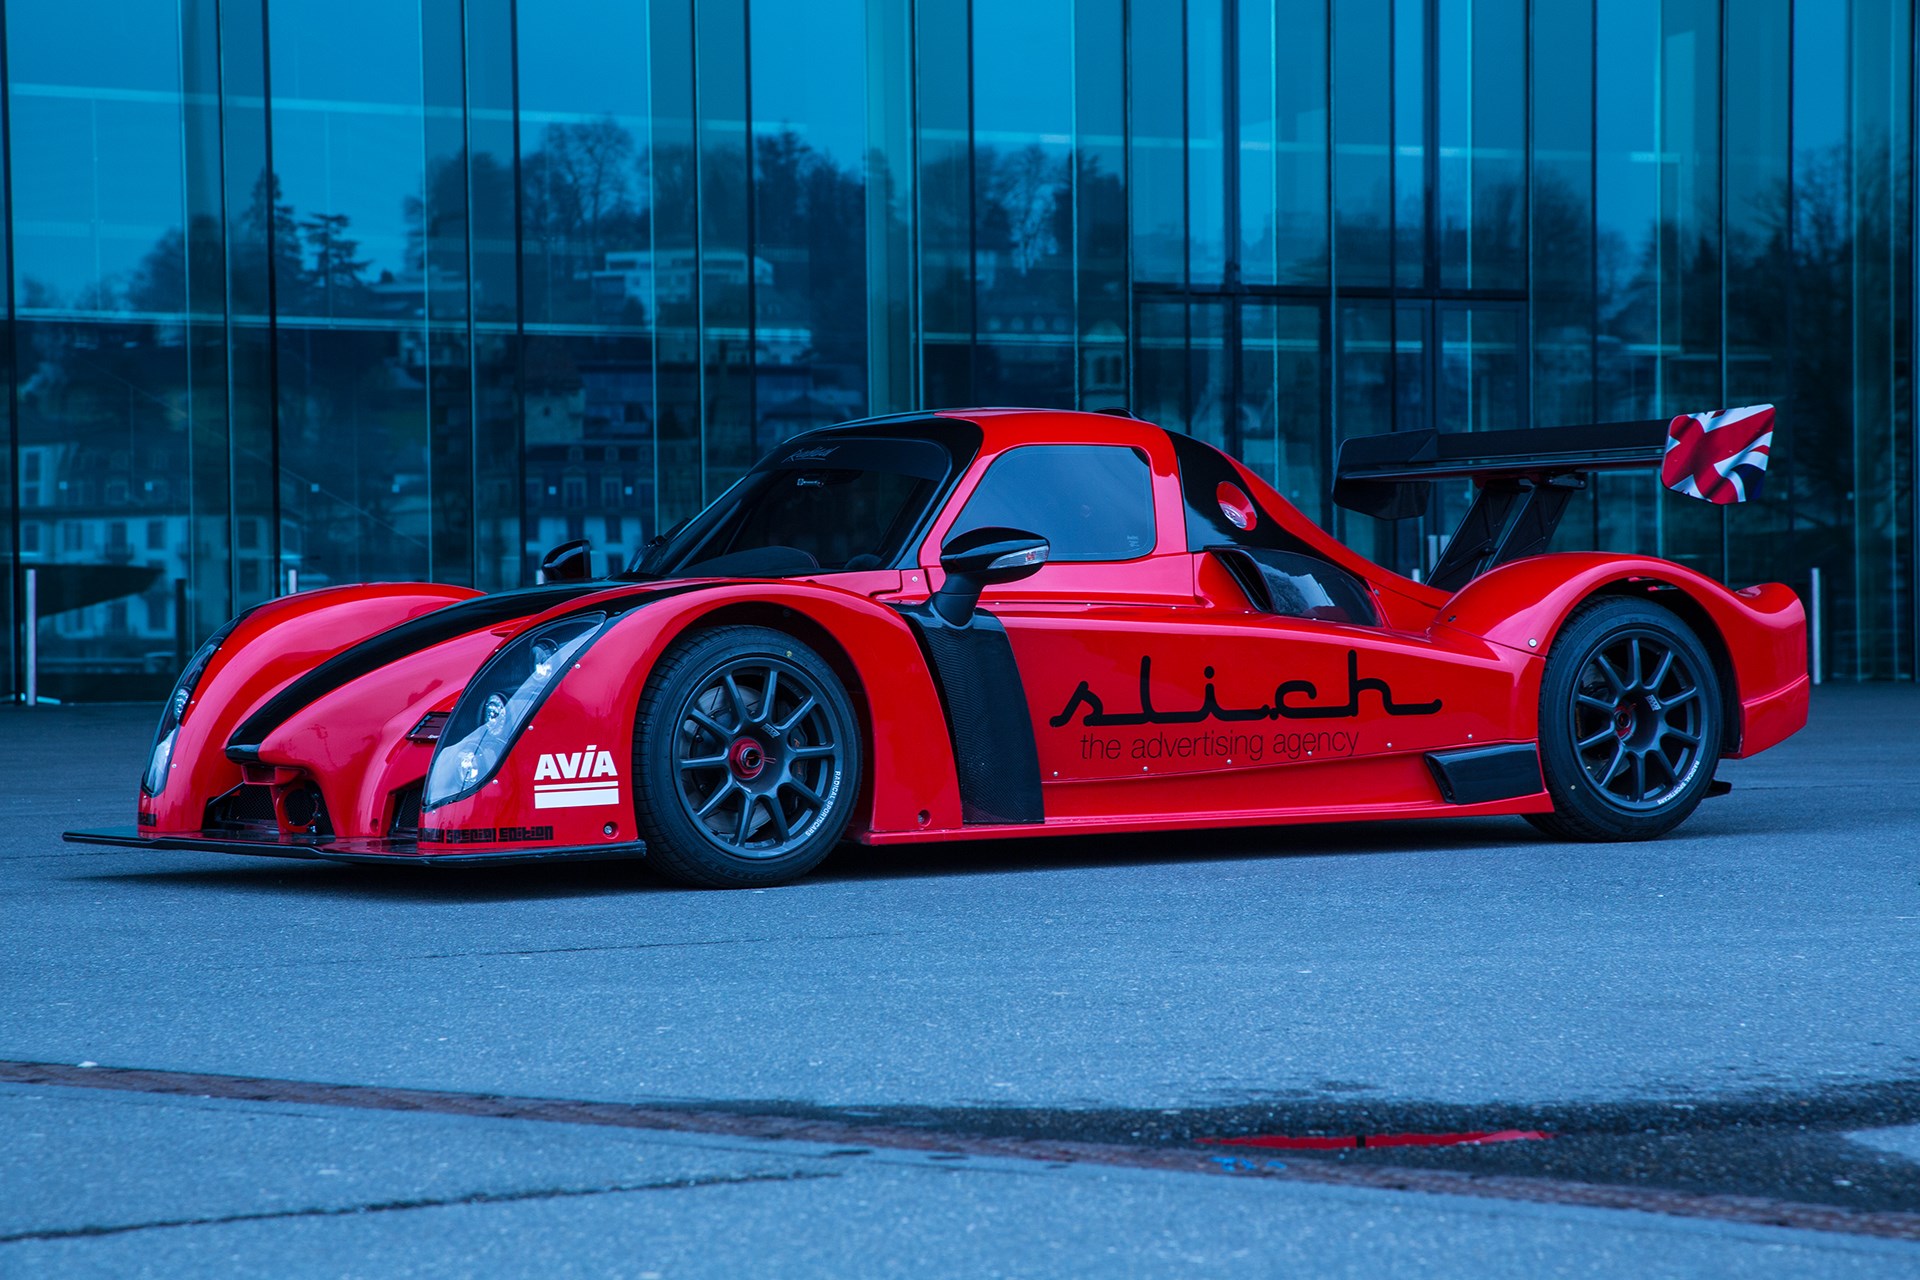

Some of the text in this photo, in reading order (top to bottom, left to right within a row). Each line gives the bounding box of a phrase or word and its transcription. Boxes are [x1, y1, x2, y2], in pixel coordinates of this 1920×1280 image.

[1080, 727, 1360, 762] the advertising agency
[804, 770, 842, 837] RADICAL SPORTSCARS
